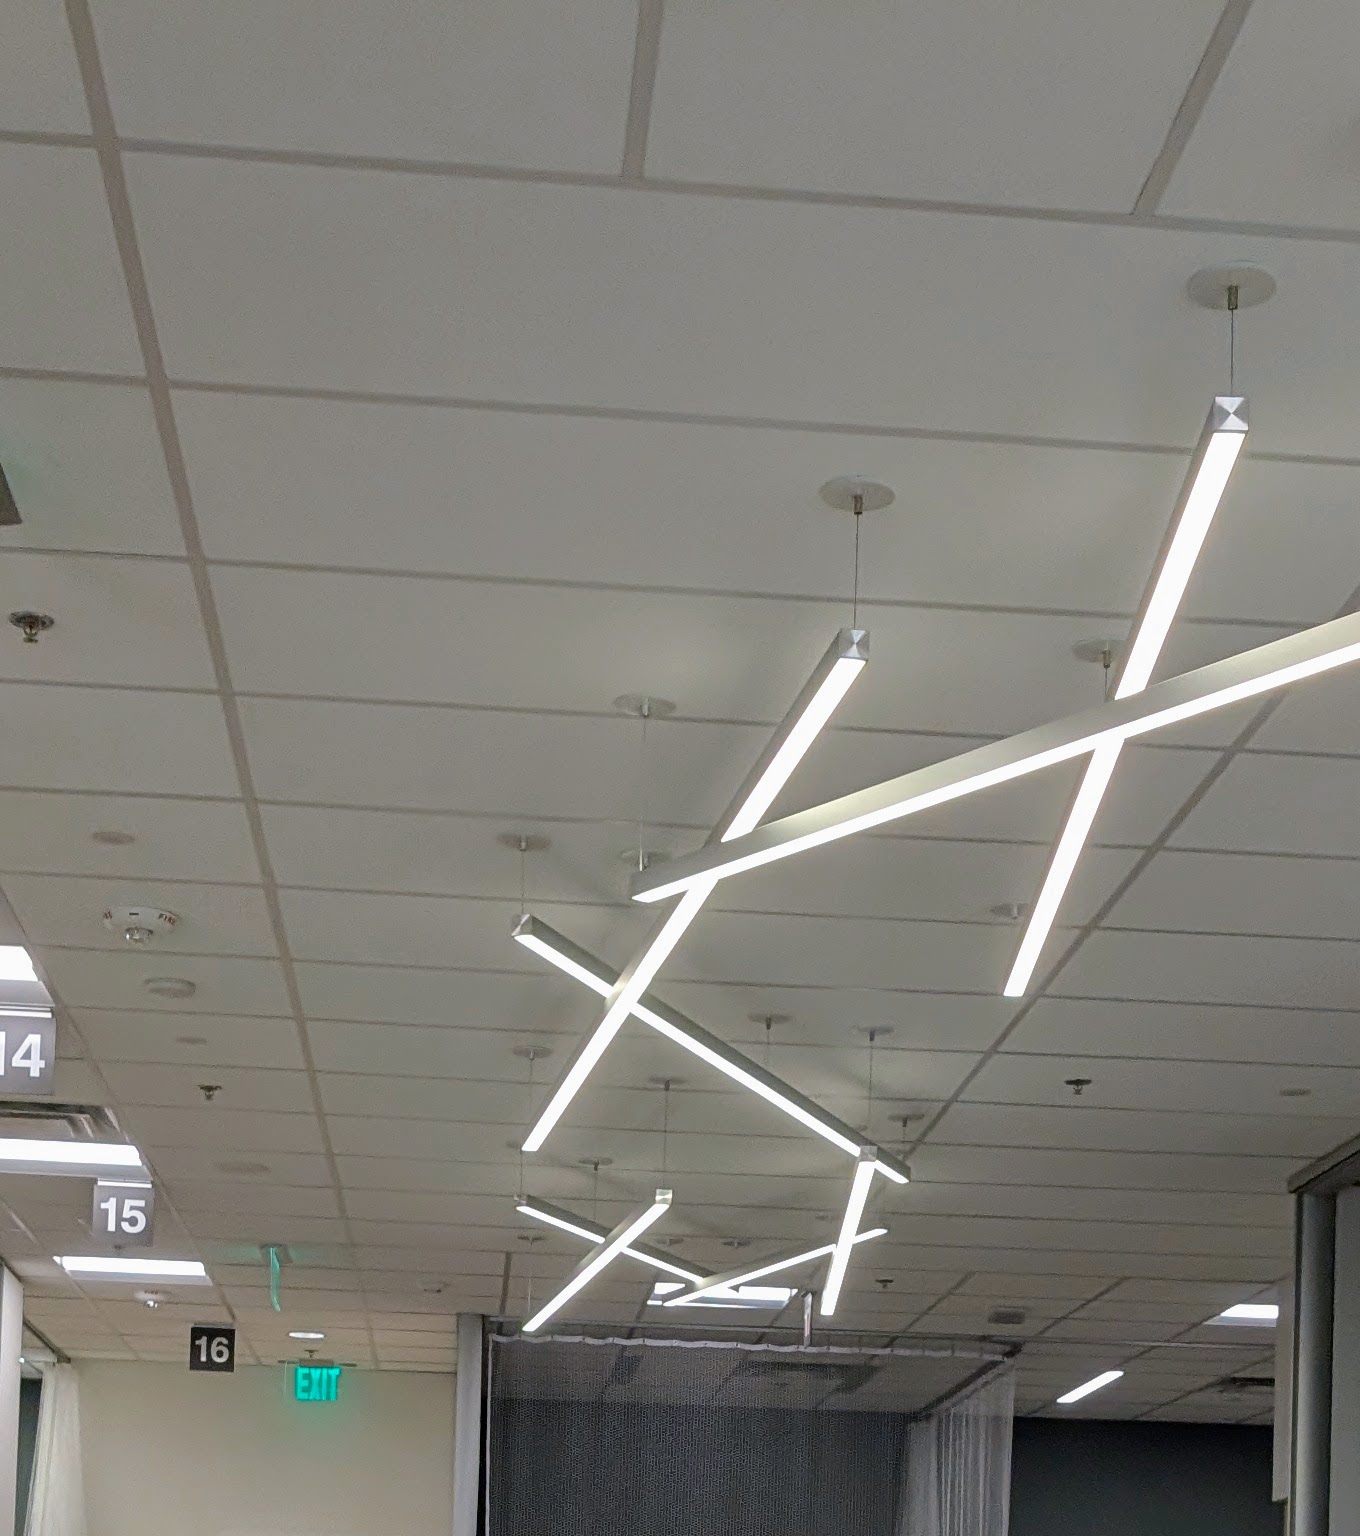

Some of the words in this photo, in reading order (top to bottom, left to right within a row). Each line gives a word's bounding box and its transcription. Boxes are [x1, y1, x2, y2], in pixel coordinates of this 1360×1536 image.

[100, 1197, 146, 1233] 15
[195, 1335, 230, 1363] 16
[296, 1367, 340, 1400] EXIT
